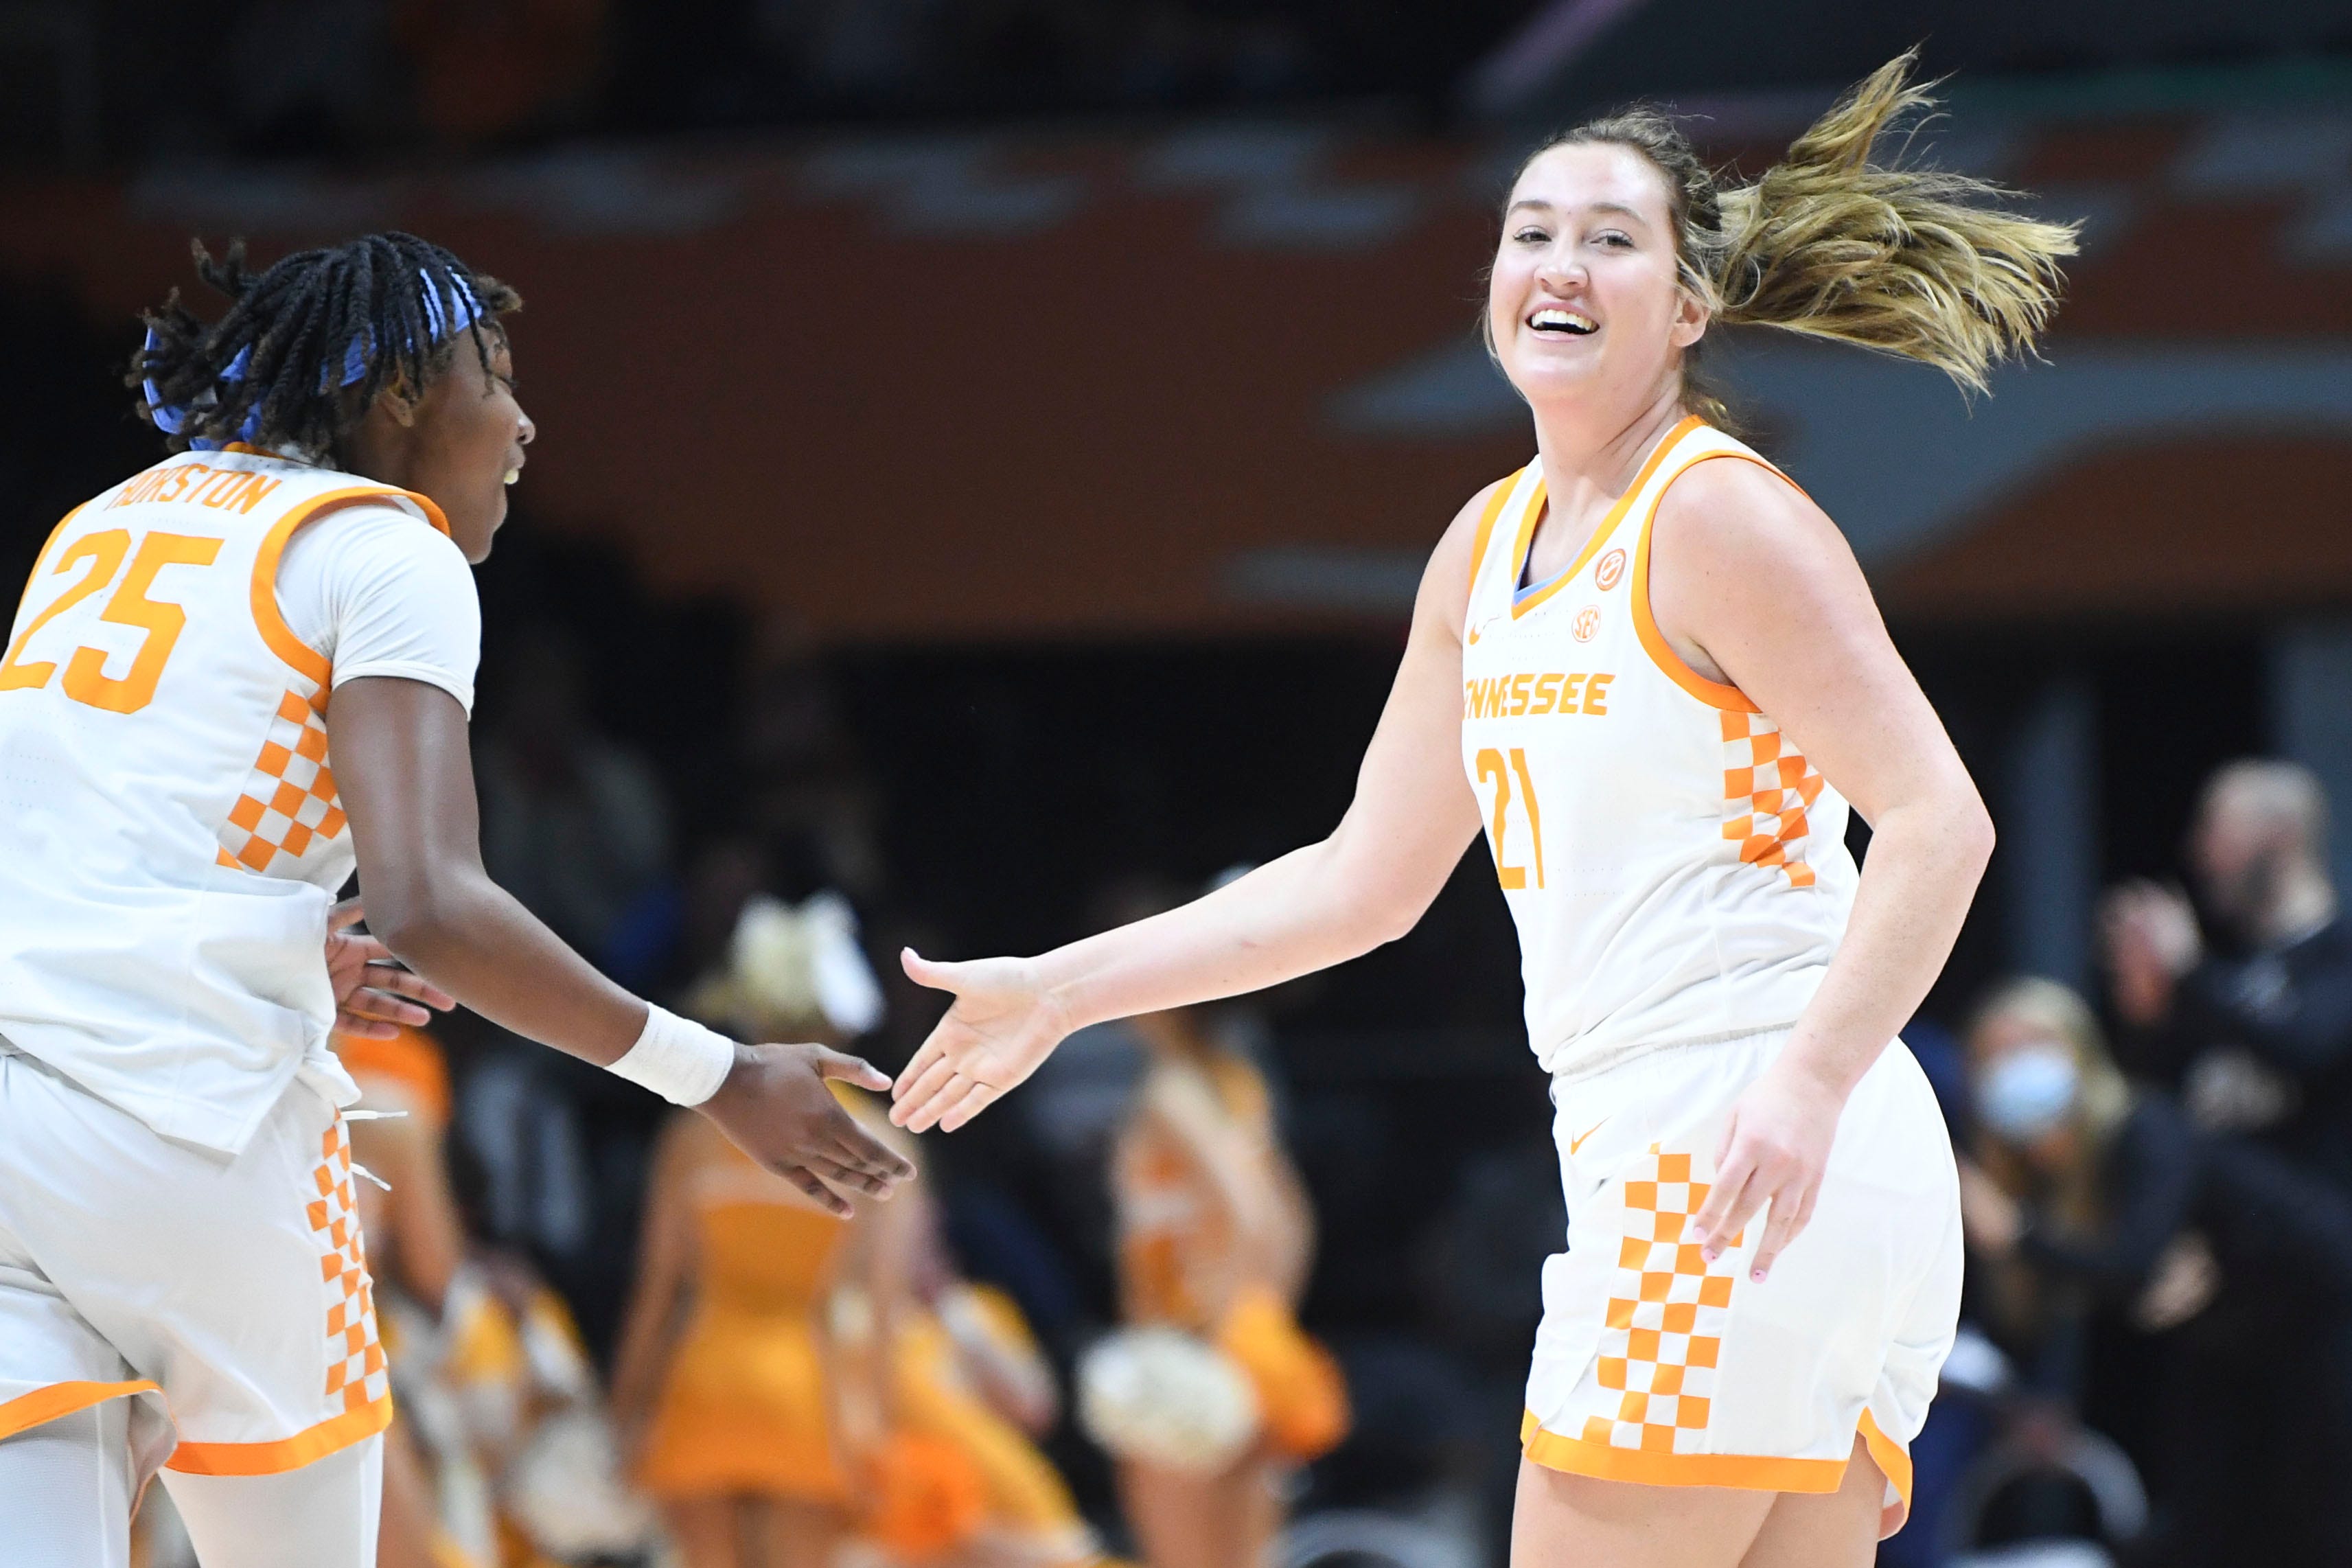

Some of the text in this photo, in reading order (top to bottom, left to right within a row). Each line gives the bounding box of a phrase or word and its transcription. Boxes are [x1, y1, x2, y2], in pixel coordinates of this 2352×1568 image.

[0, 528, 224, 715] 25
[1573, 606, 1600, 640] SEC
[1475, 748, 1544, 889] 21
